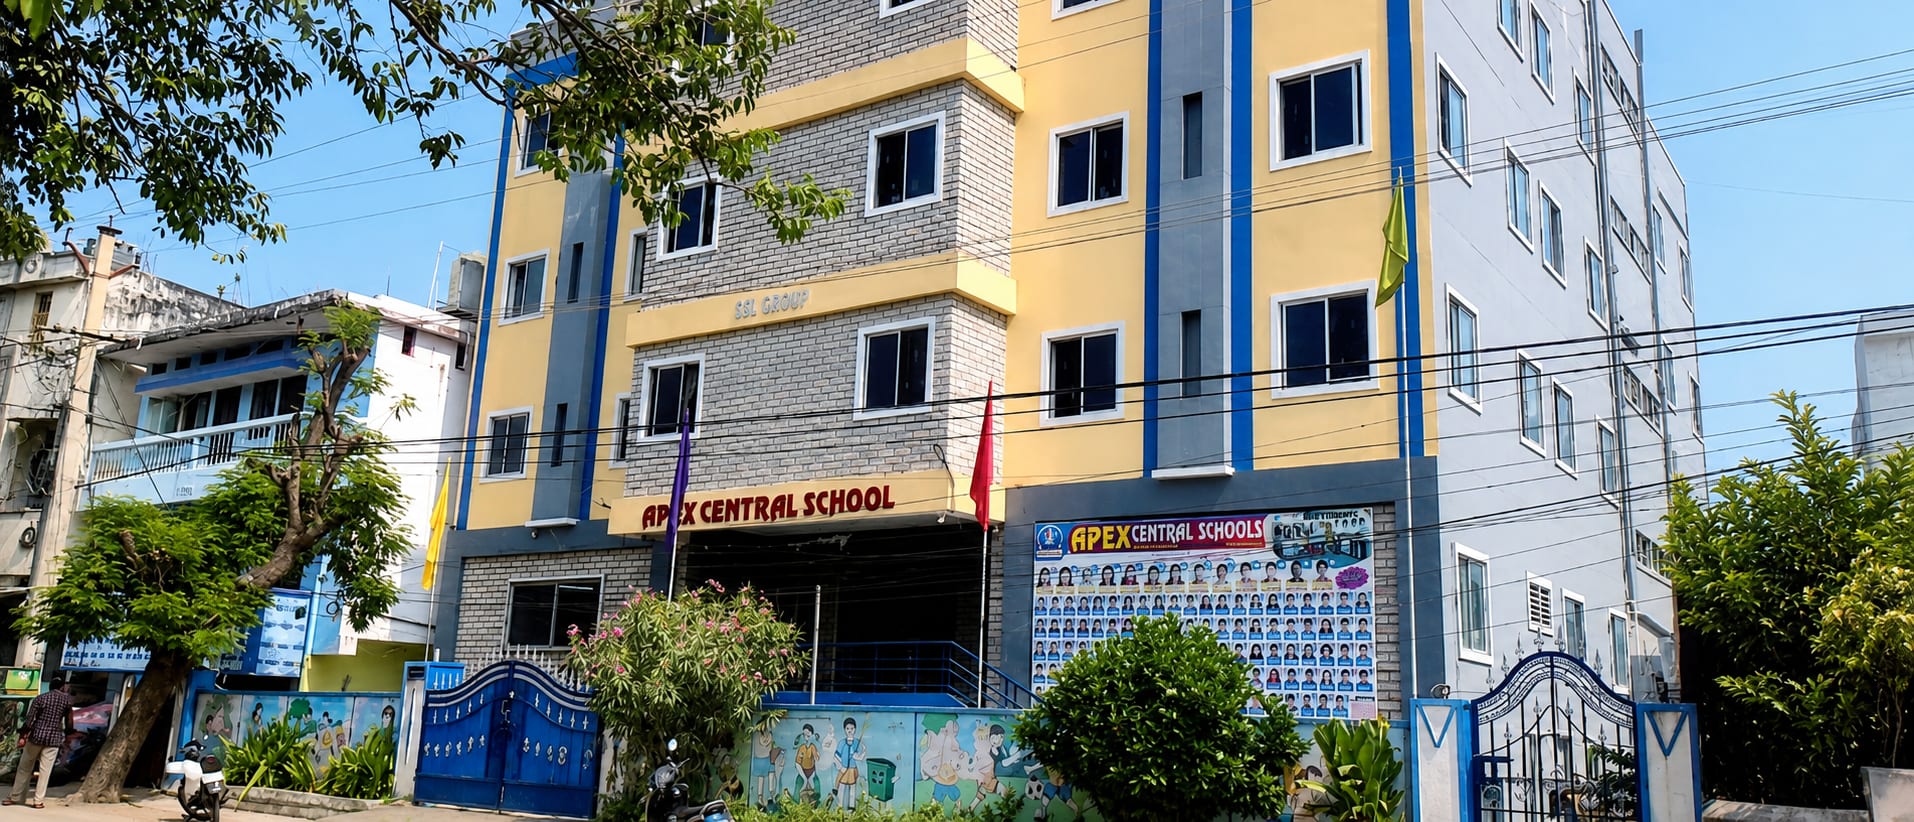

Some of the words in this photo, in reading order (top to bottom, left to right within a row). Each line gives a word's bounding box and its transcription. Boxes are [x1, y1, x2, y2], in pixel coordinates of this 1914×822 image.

[735, 298, 757, 320] SSL
[761, 289, 810, 315] GROUP
[700, 494, 798, 524] CENTRAL
[803, 485, 896, 517] SCHOOL
[1070, 524, 1133, 553] APEX
[1131, 522, 1194, 543] CENTRAL
[1198, 519, 1263, 542] SCHOOLS
